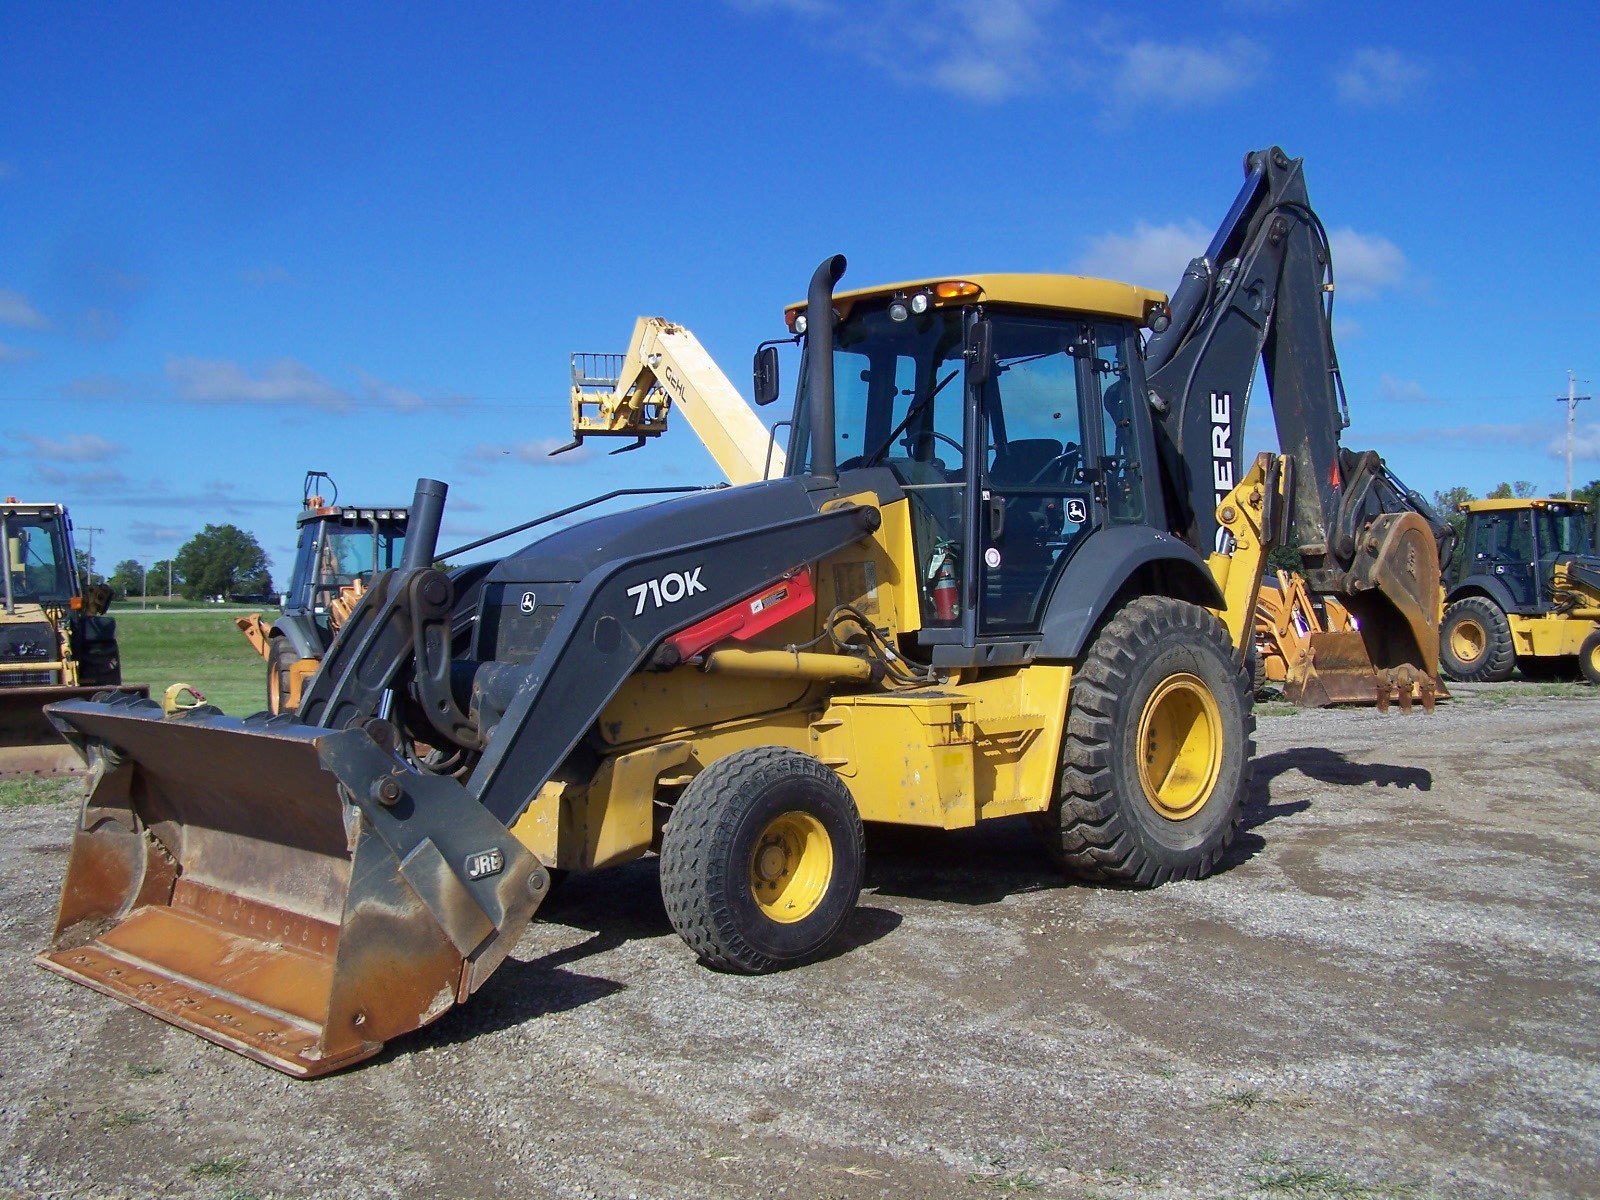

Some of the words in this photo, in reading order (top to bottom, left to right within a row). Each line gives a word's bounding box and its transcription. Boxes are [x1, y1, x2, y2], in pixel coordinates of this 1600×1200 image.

[665, 366, 687, 403] GEHL
[1210, 393, 1236, 557] ERE
[626, 566, 707, 616] 710K
